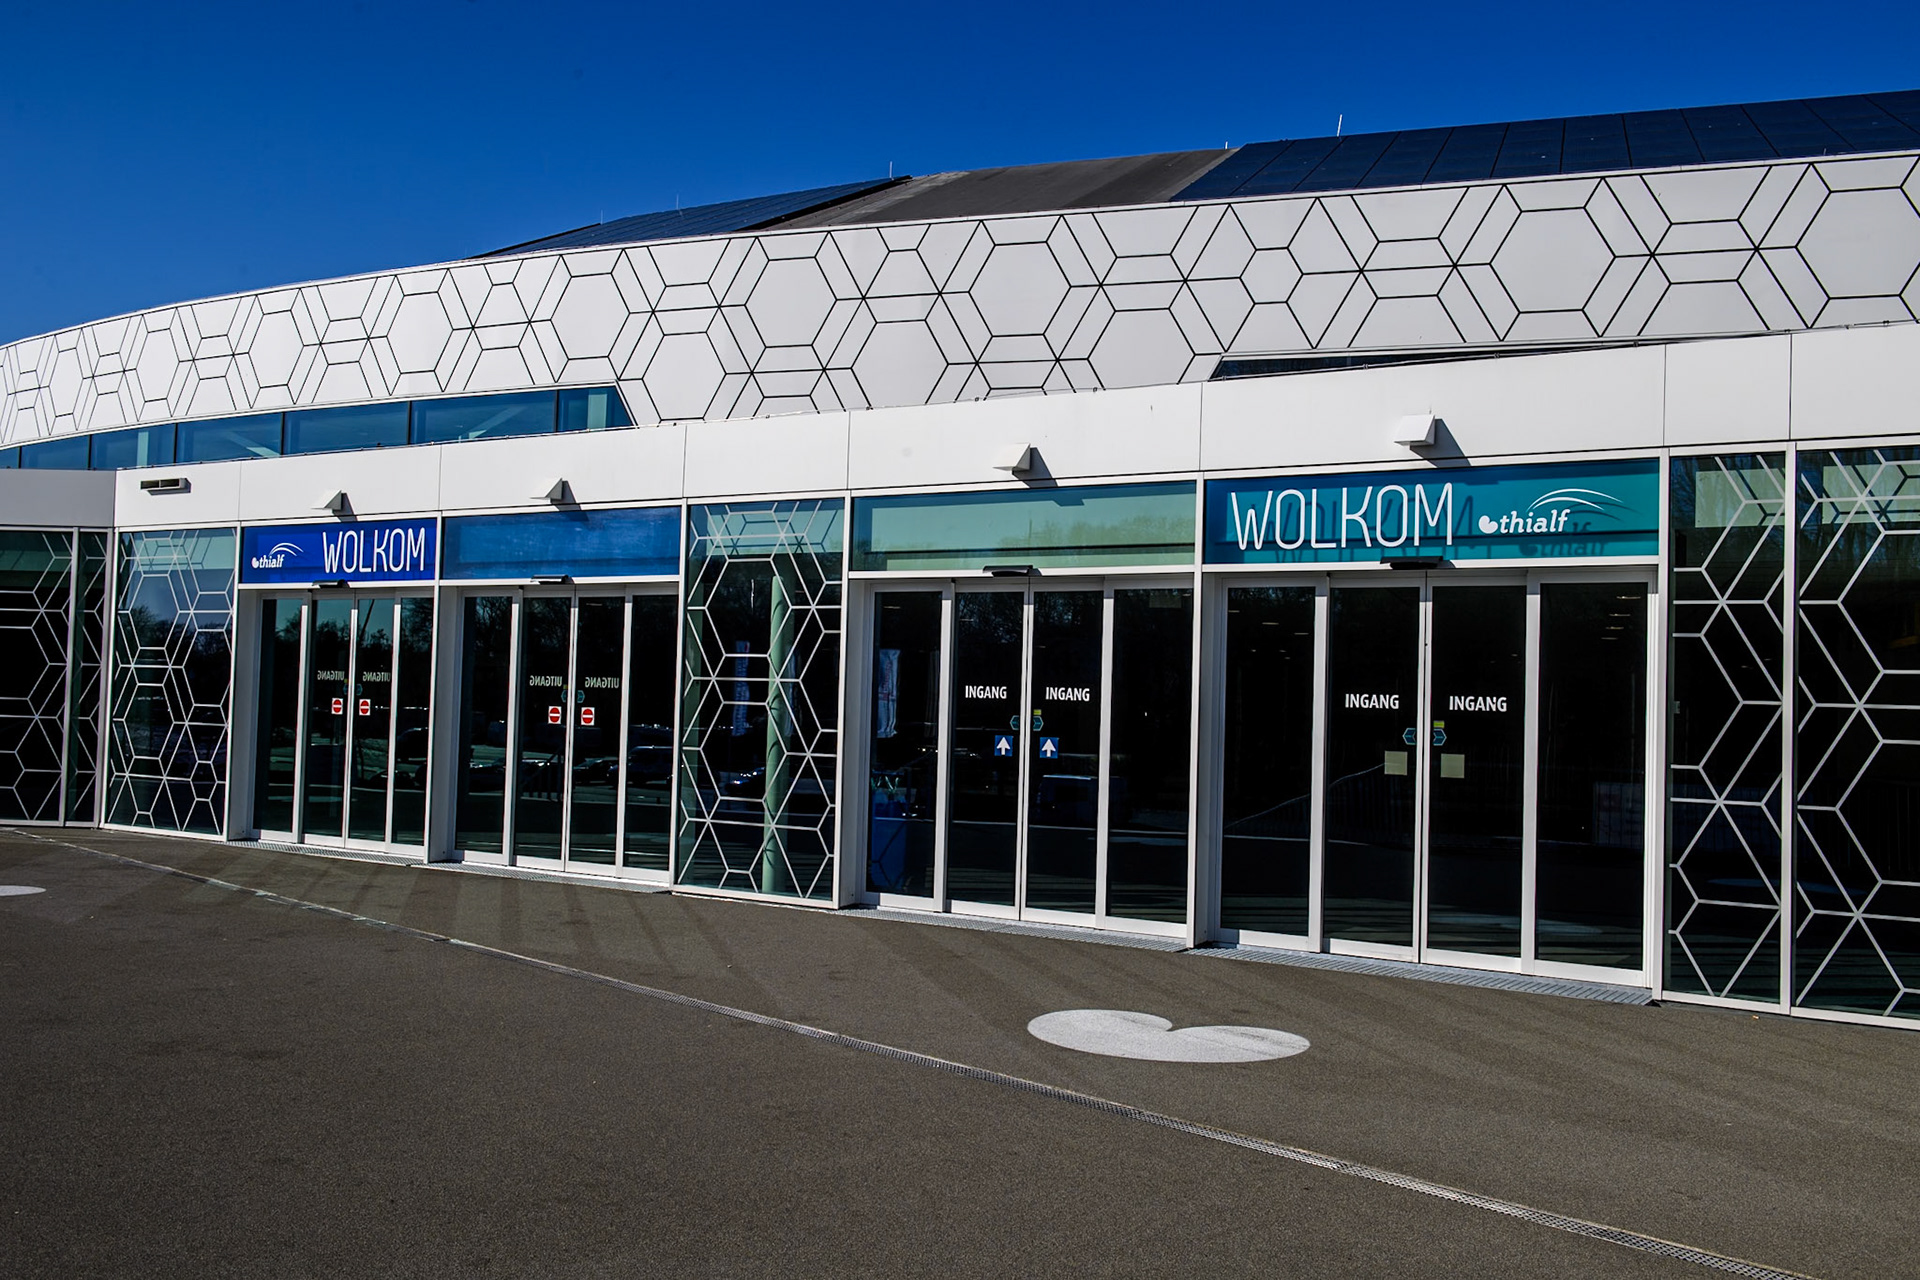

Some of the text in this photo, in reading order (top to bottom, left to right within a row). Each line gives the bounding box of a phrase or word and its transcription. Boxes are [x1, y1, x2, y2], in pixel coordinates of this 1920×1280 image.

[1231, 482, 1570, 551] WOLKOM thialf
[259, 527, 426, 573] thialf WOLKOM
[965, 685, 1007, 699] INGANG
[1045, 687, 1090, 702] INGANG
[1345, 694, 1399, 709] INGANG
[1449, 696, 1507, 712] INGANG
